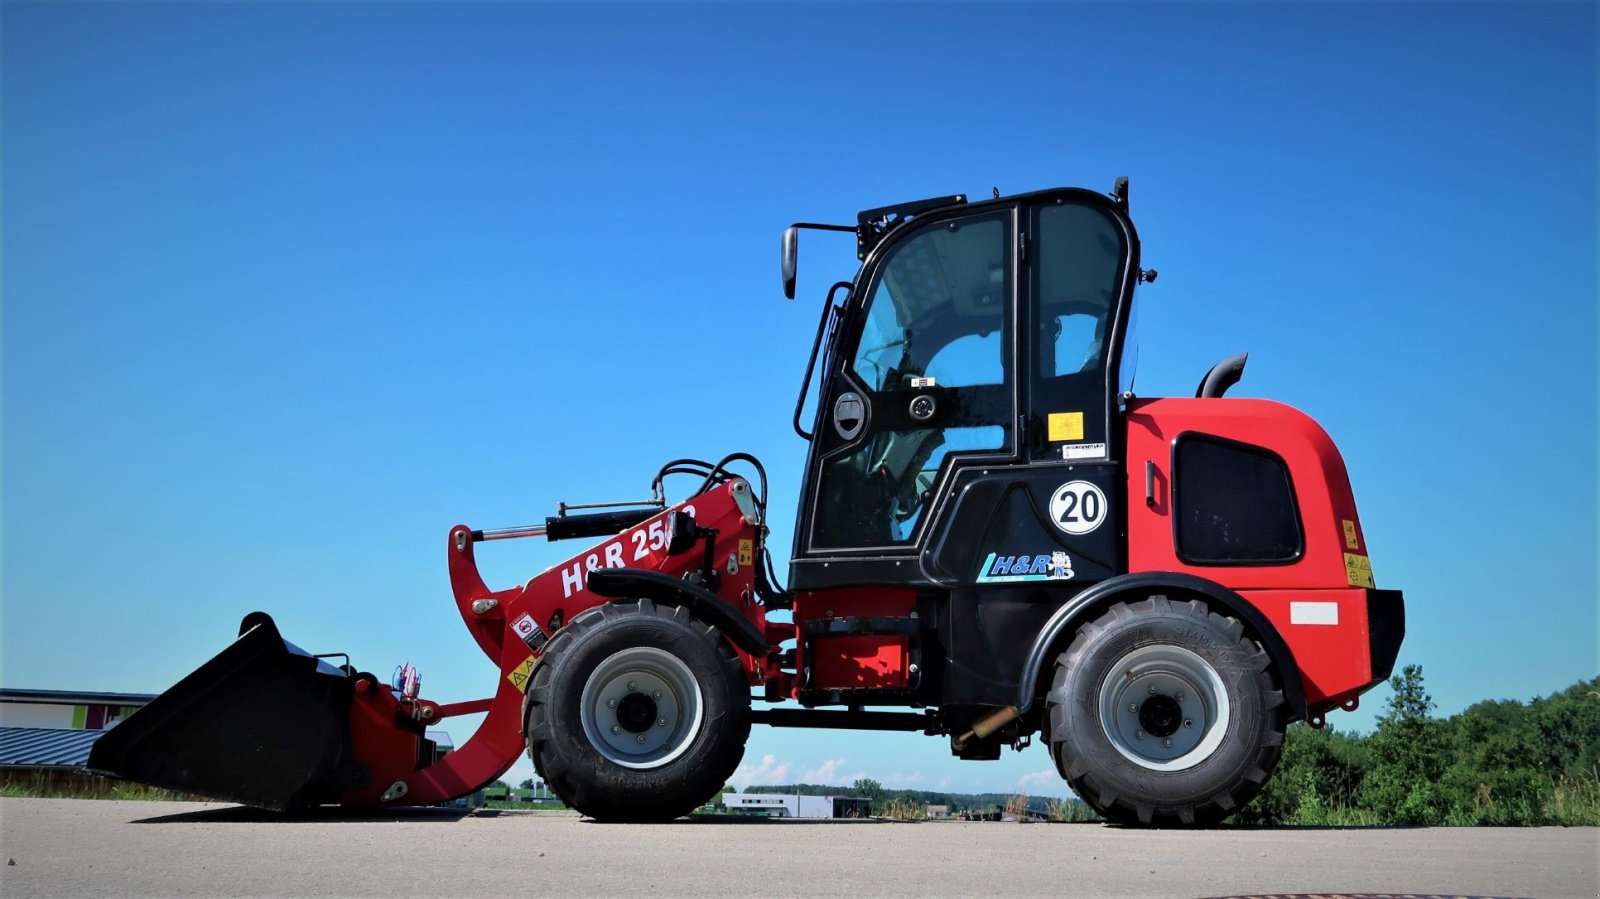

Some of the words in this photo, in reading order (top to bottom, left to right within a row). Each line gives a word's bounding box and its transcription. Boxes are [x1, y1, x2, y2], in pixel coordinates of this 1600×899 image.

[1060, 490, 1100, 523] 20
[561, 541, 625, 599] H&R
[991, 555, 1052, 575] H&R
